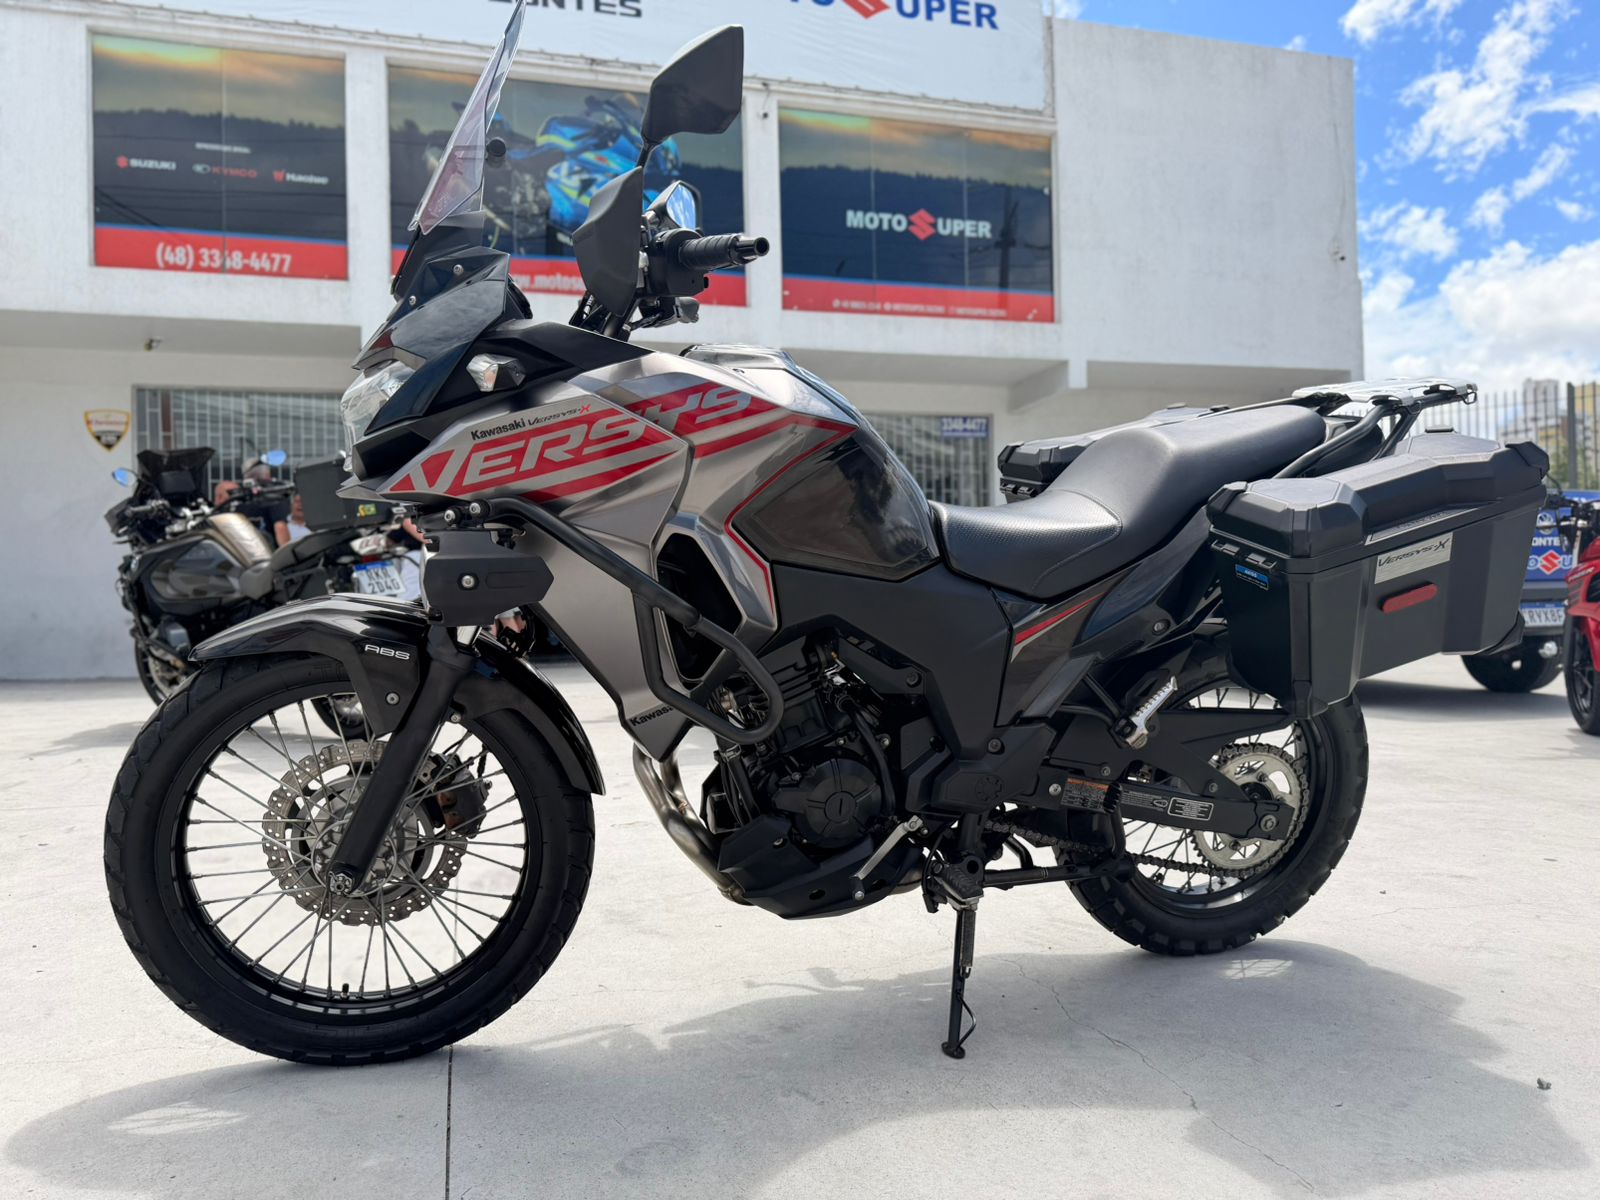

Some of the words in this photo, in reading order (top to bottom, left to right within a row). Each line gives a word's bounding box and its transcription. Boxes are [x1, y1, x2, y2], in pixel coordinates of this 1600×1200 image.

[129, 157, 176, 171] SUZUKI
[846, 210, 908, 232] MOTO
[156, 242, 195, 270] (48)
[470, 417, 526, 441] Kawasaki
[364, 644, 410, 660] ABS
[629, 704, 674, 727] Kawas
